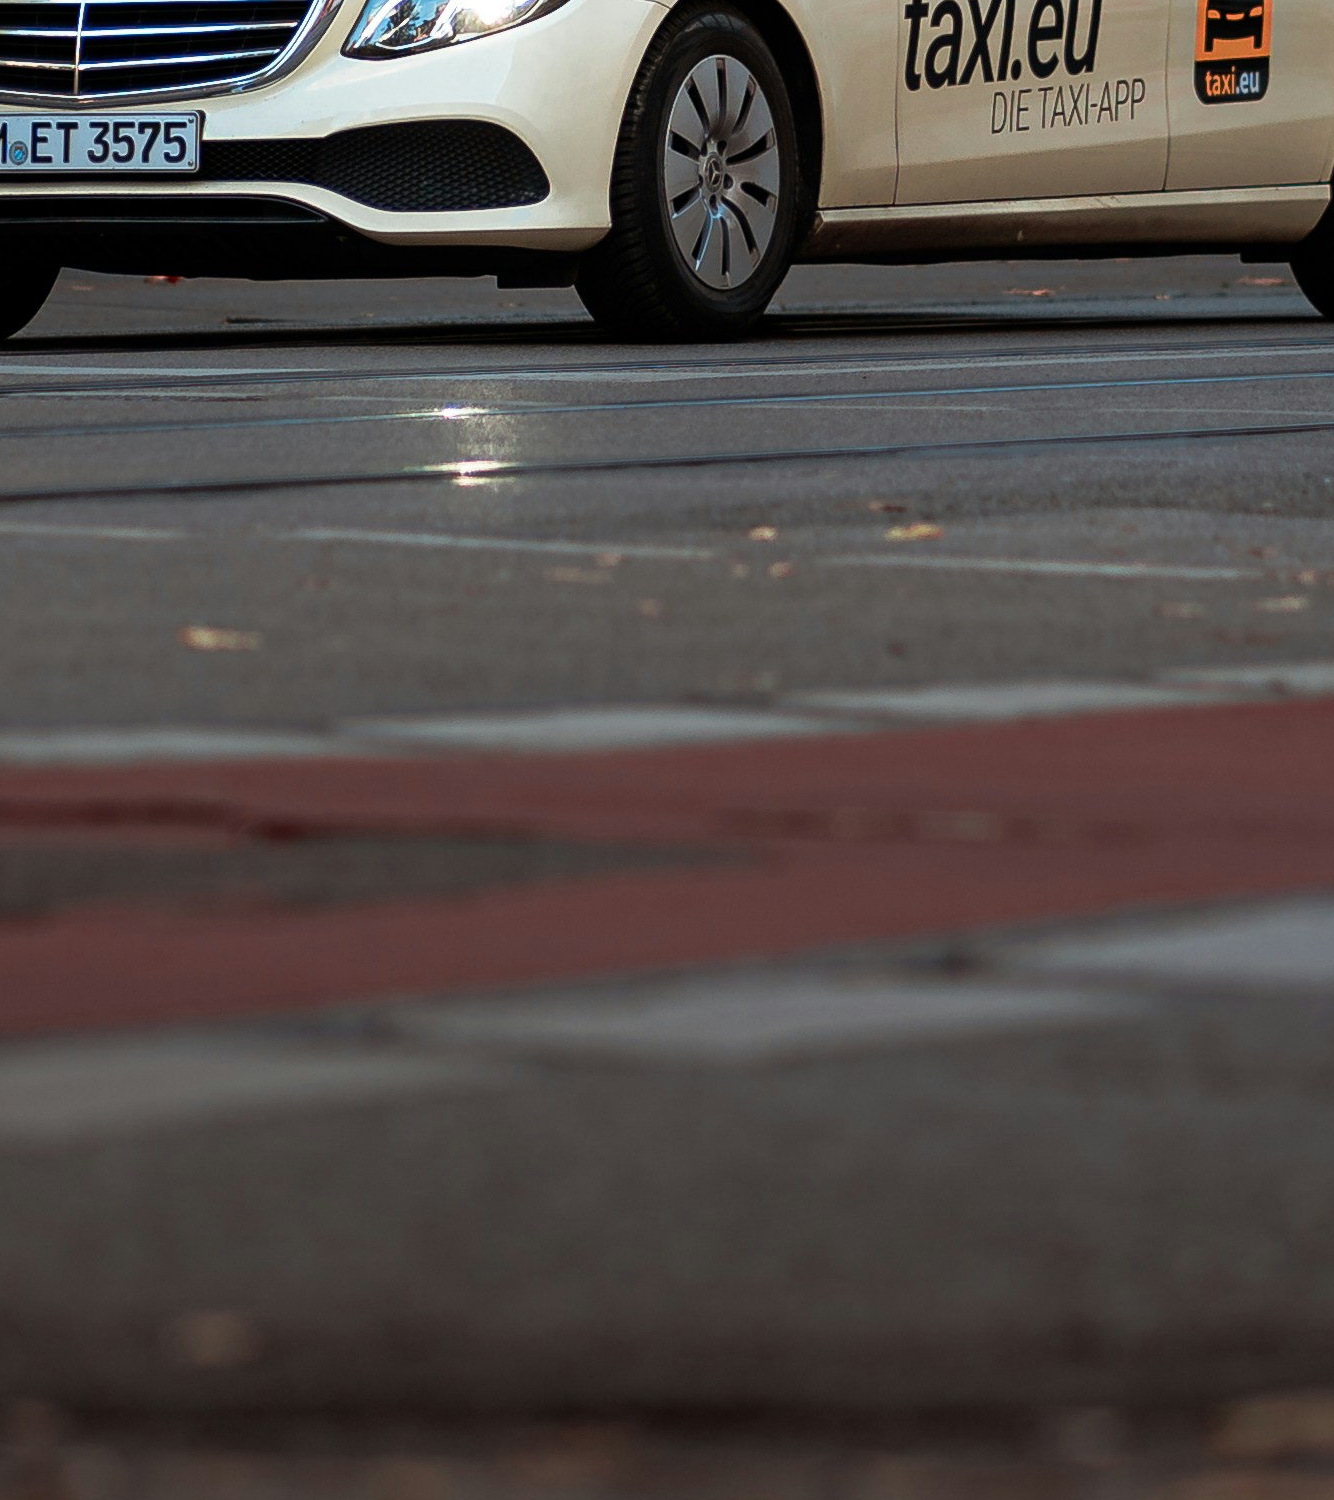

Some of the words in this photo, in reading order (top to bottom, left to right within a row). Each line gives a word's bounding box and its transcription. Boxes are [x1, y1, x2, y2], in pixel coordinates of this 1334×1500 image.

[1205, 65, 1261, 98] taxi.eu
[990, 88, 1033, 135] DIE
[1037, 77, 1146, 129] TAXI-APP
[30, 121, 79, 164] ET
[86, 121, 188, 164] 3575
